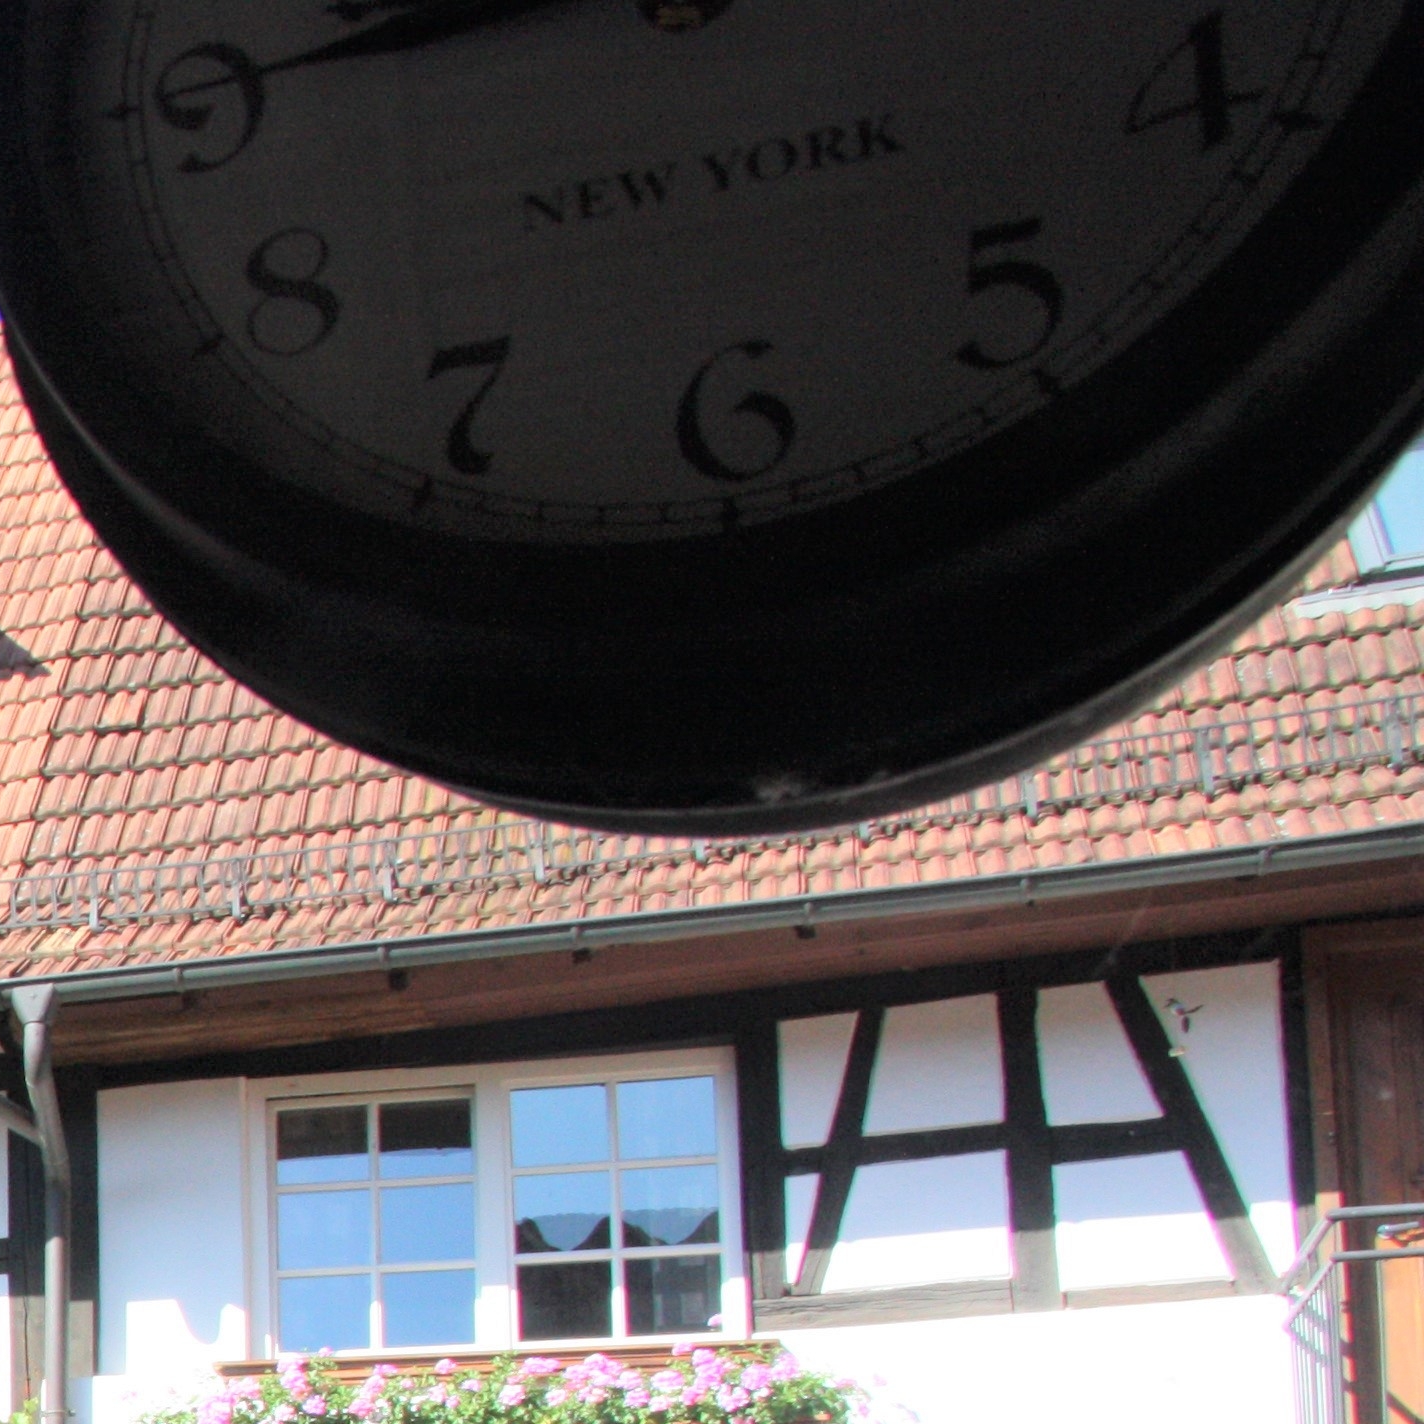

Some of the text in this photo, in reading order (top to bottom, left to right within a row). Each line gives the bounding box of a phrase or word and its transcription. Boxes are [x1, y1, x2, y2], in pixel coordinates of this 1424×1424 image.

[154, 41, 264, 174] 9
[1124, 6, 1262, 152] 4
[522, 113, 905, 232] NEW YORK
[246, 227, 342, 356] 8
[957, 216, 1064, 370] 5
[426, 335, 512, 475] 7
[675, 339, 796, 481] 6
